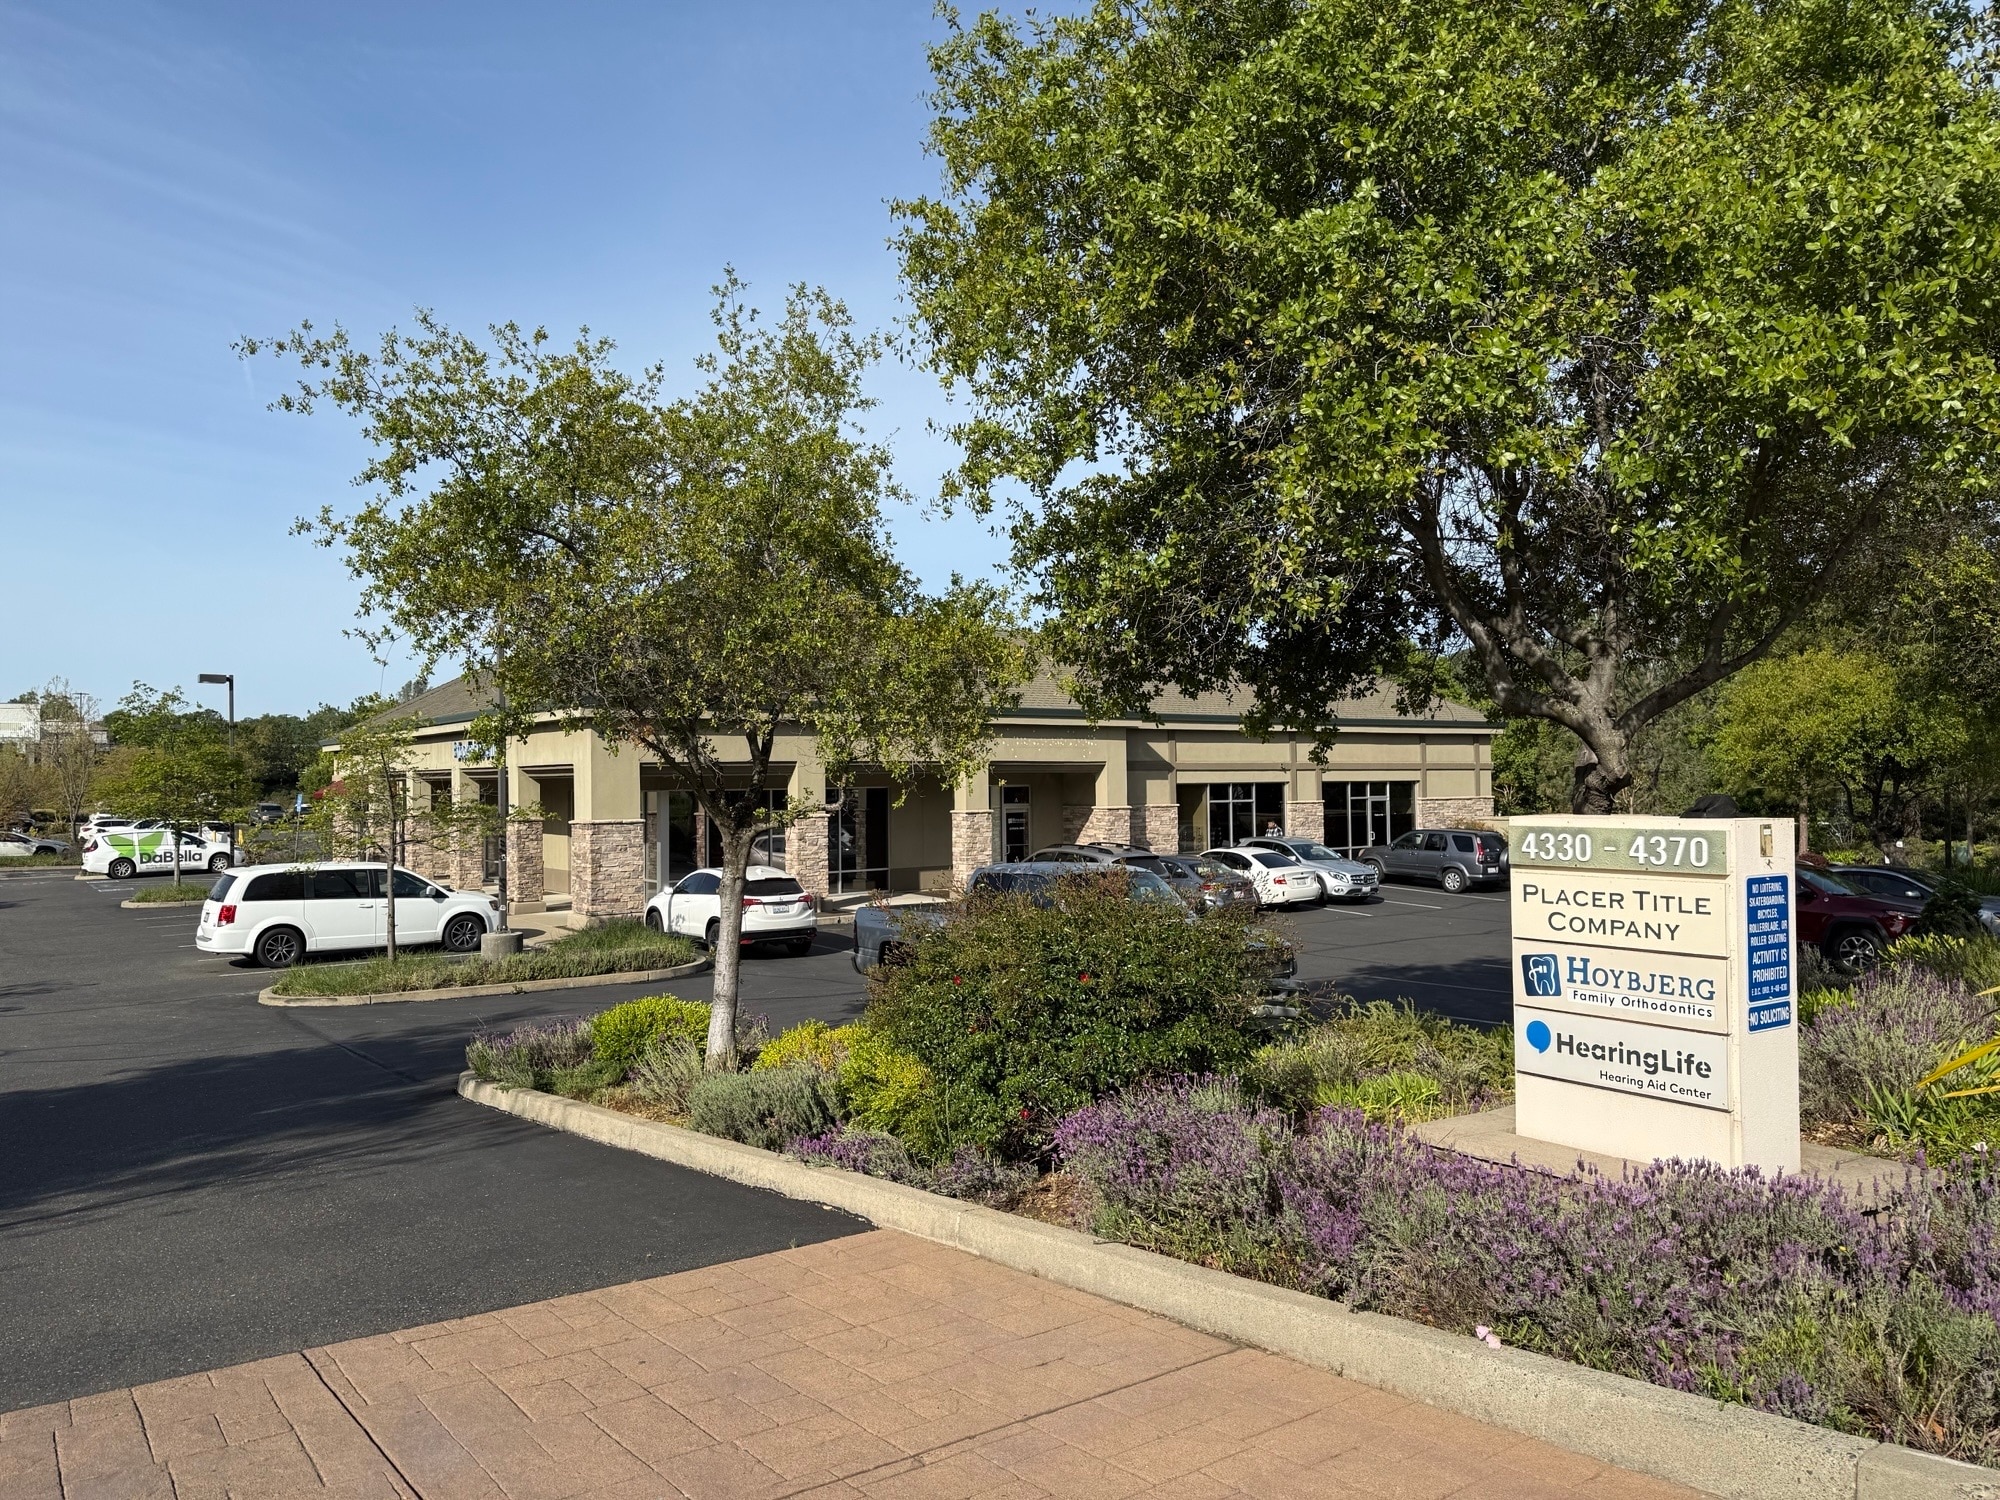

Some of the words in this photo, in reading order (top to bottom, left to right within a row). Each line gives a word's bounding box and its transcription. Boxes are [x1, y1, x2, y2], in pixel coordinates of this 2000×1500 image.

[1521, 833, 1592, 862] 4330
[1629, 836, 1709, 867] 4370
[1523, 884, 1625, 910] PLACER
[1632, 891, 1711, 915] TITLE
[1752, 884, 1759, 893] NO
[1548, 911, 1680, 941] COMPANY
[1781, 920, 1787, 930] OR
[1751, 935, 1767, 946] ROLLER
[1768, 933, 1787, 944] SKATING
[1752, 949, 1779, 965] ACTIVITY
[1781, 948, 1787, 960] IS
[1567, 956, 1716, 1001] HOYBJERG
[1752, 966, 1787, 983] PROHIBITED
[1573, 990, 1615, 1007] Family
[1621, 996, 1713, 1018] Orthodontics
[1750, 1012, 1758, 1026] NO
[1760, 1006, 1789, 1024] SOLICITING
[1556, 1032, 1712, 1079] HearingLife
[1600, 1070, 1644, 1090] Hearing
[1647, 1079, 1667, 1093] Aid
[1669, 1083, 1712, 1100] Center
